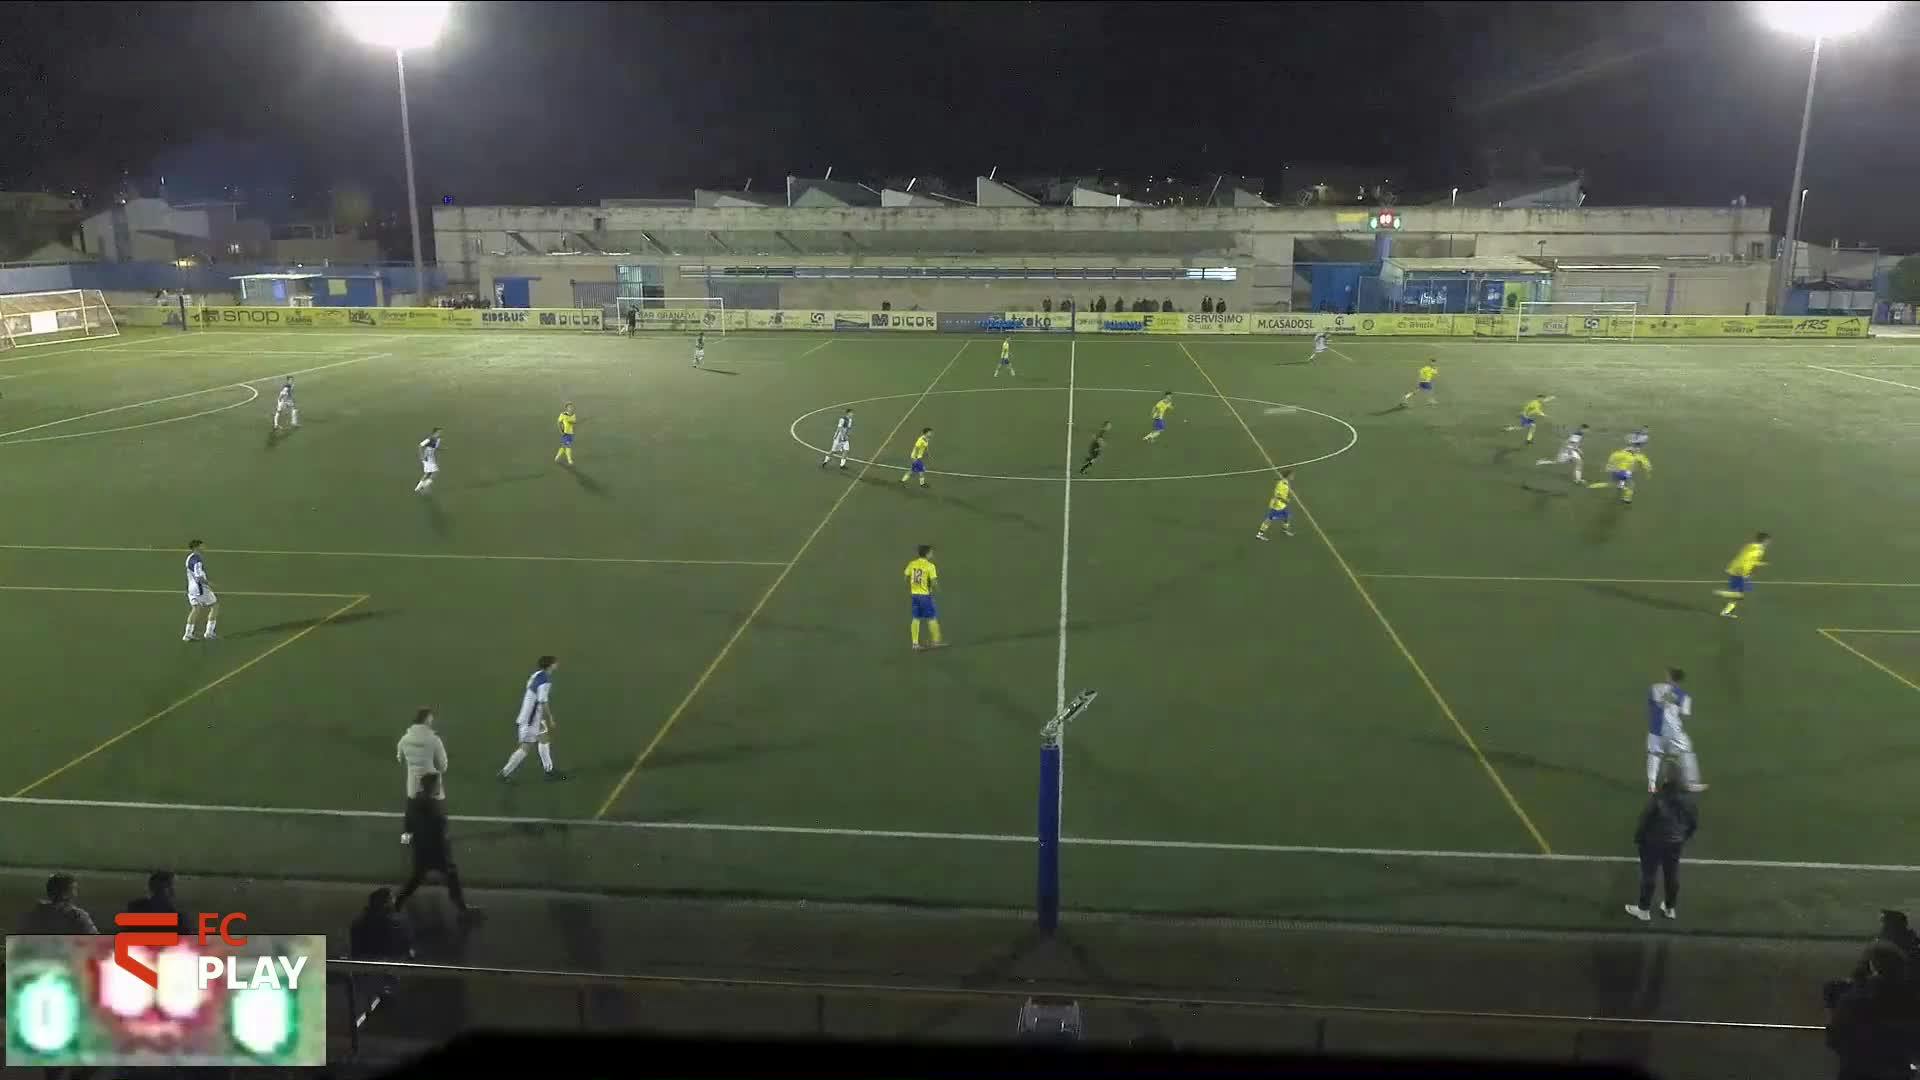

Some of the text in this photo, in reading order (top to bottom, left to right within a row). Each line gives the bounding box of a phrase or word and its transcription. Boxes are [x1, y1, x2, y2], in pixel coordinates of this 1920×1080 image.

[223, 310, 279, 325] snop
[559, 315, 599, 325] DICOR
[892, 316, 934, 327] DICOR
[1795, 319, 1829, 330] ARS
[912, 568, 923, 584] 12
